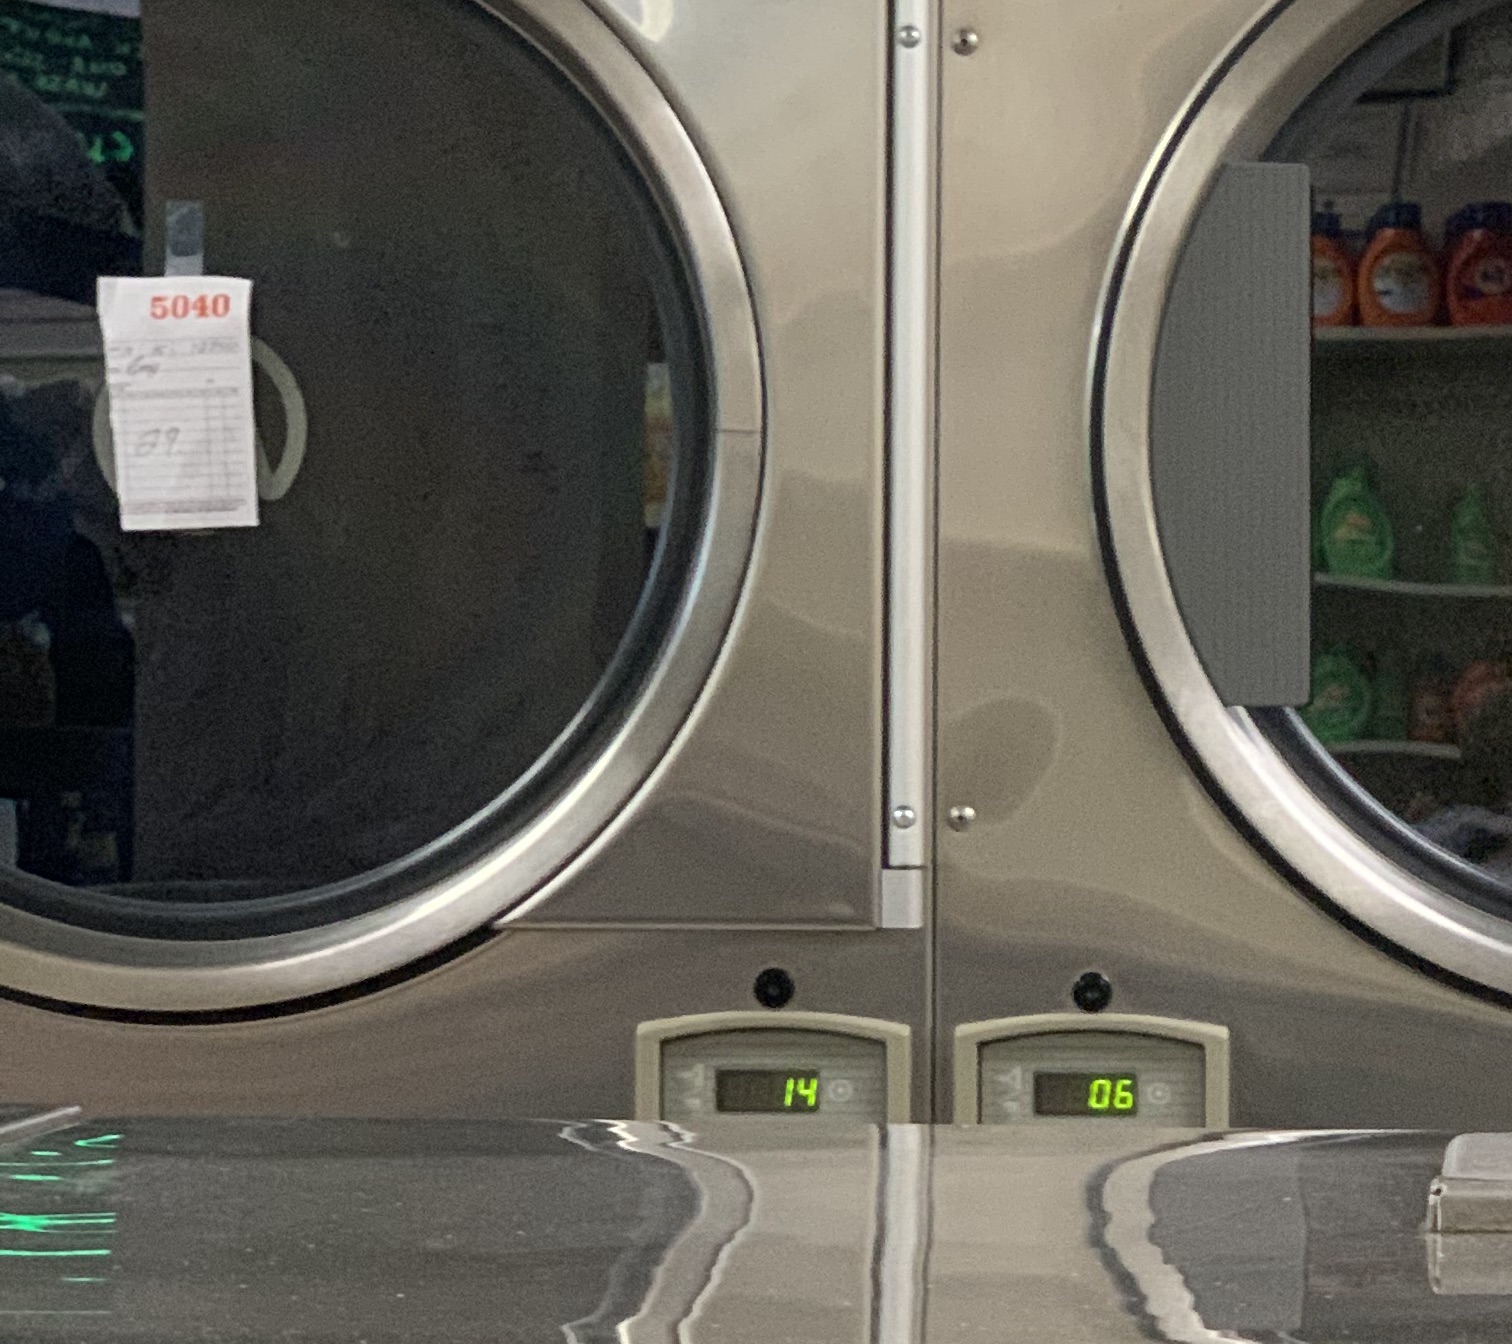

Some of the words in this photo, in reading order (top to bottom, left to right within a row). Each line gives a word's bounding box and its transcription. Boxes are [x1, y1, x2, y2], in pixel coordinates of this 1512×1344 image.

[151, 293, 232, 320] 5040
[784, 1077, 818, 1107] 14
[1088, 1078, 1133, 1109] 06
